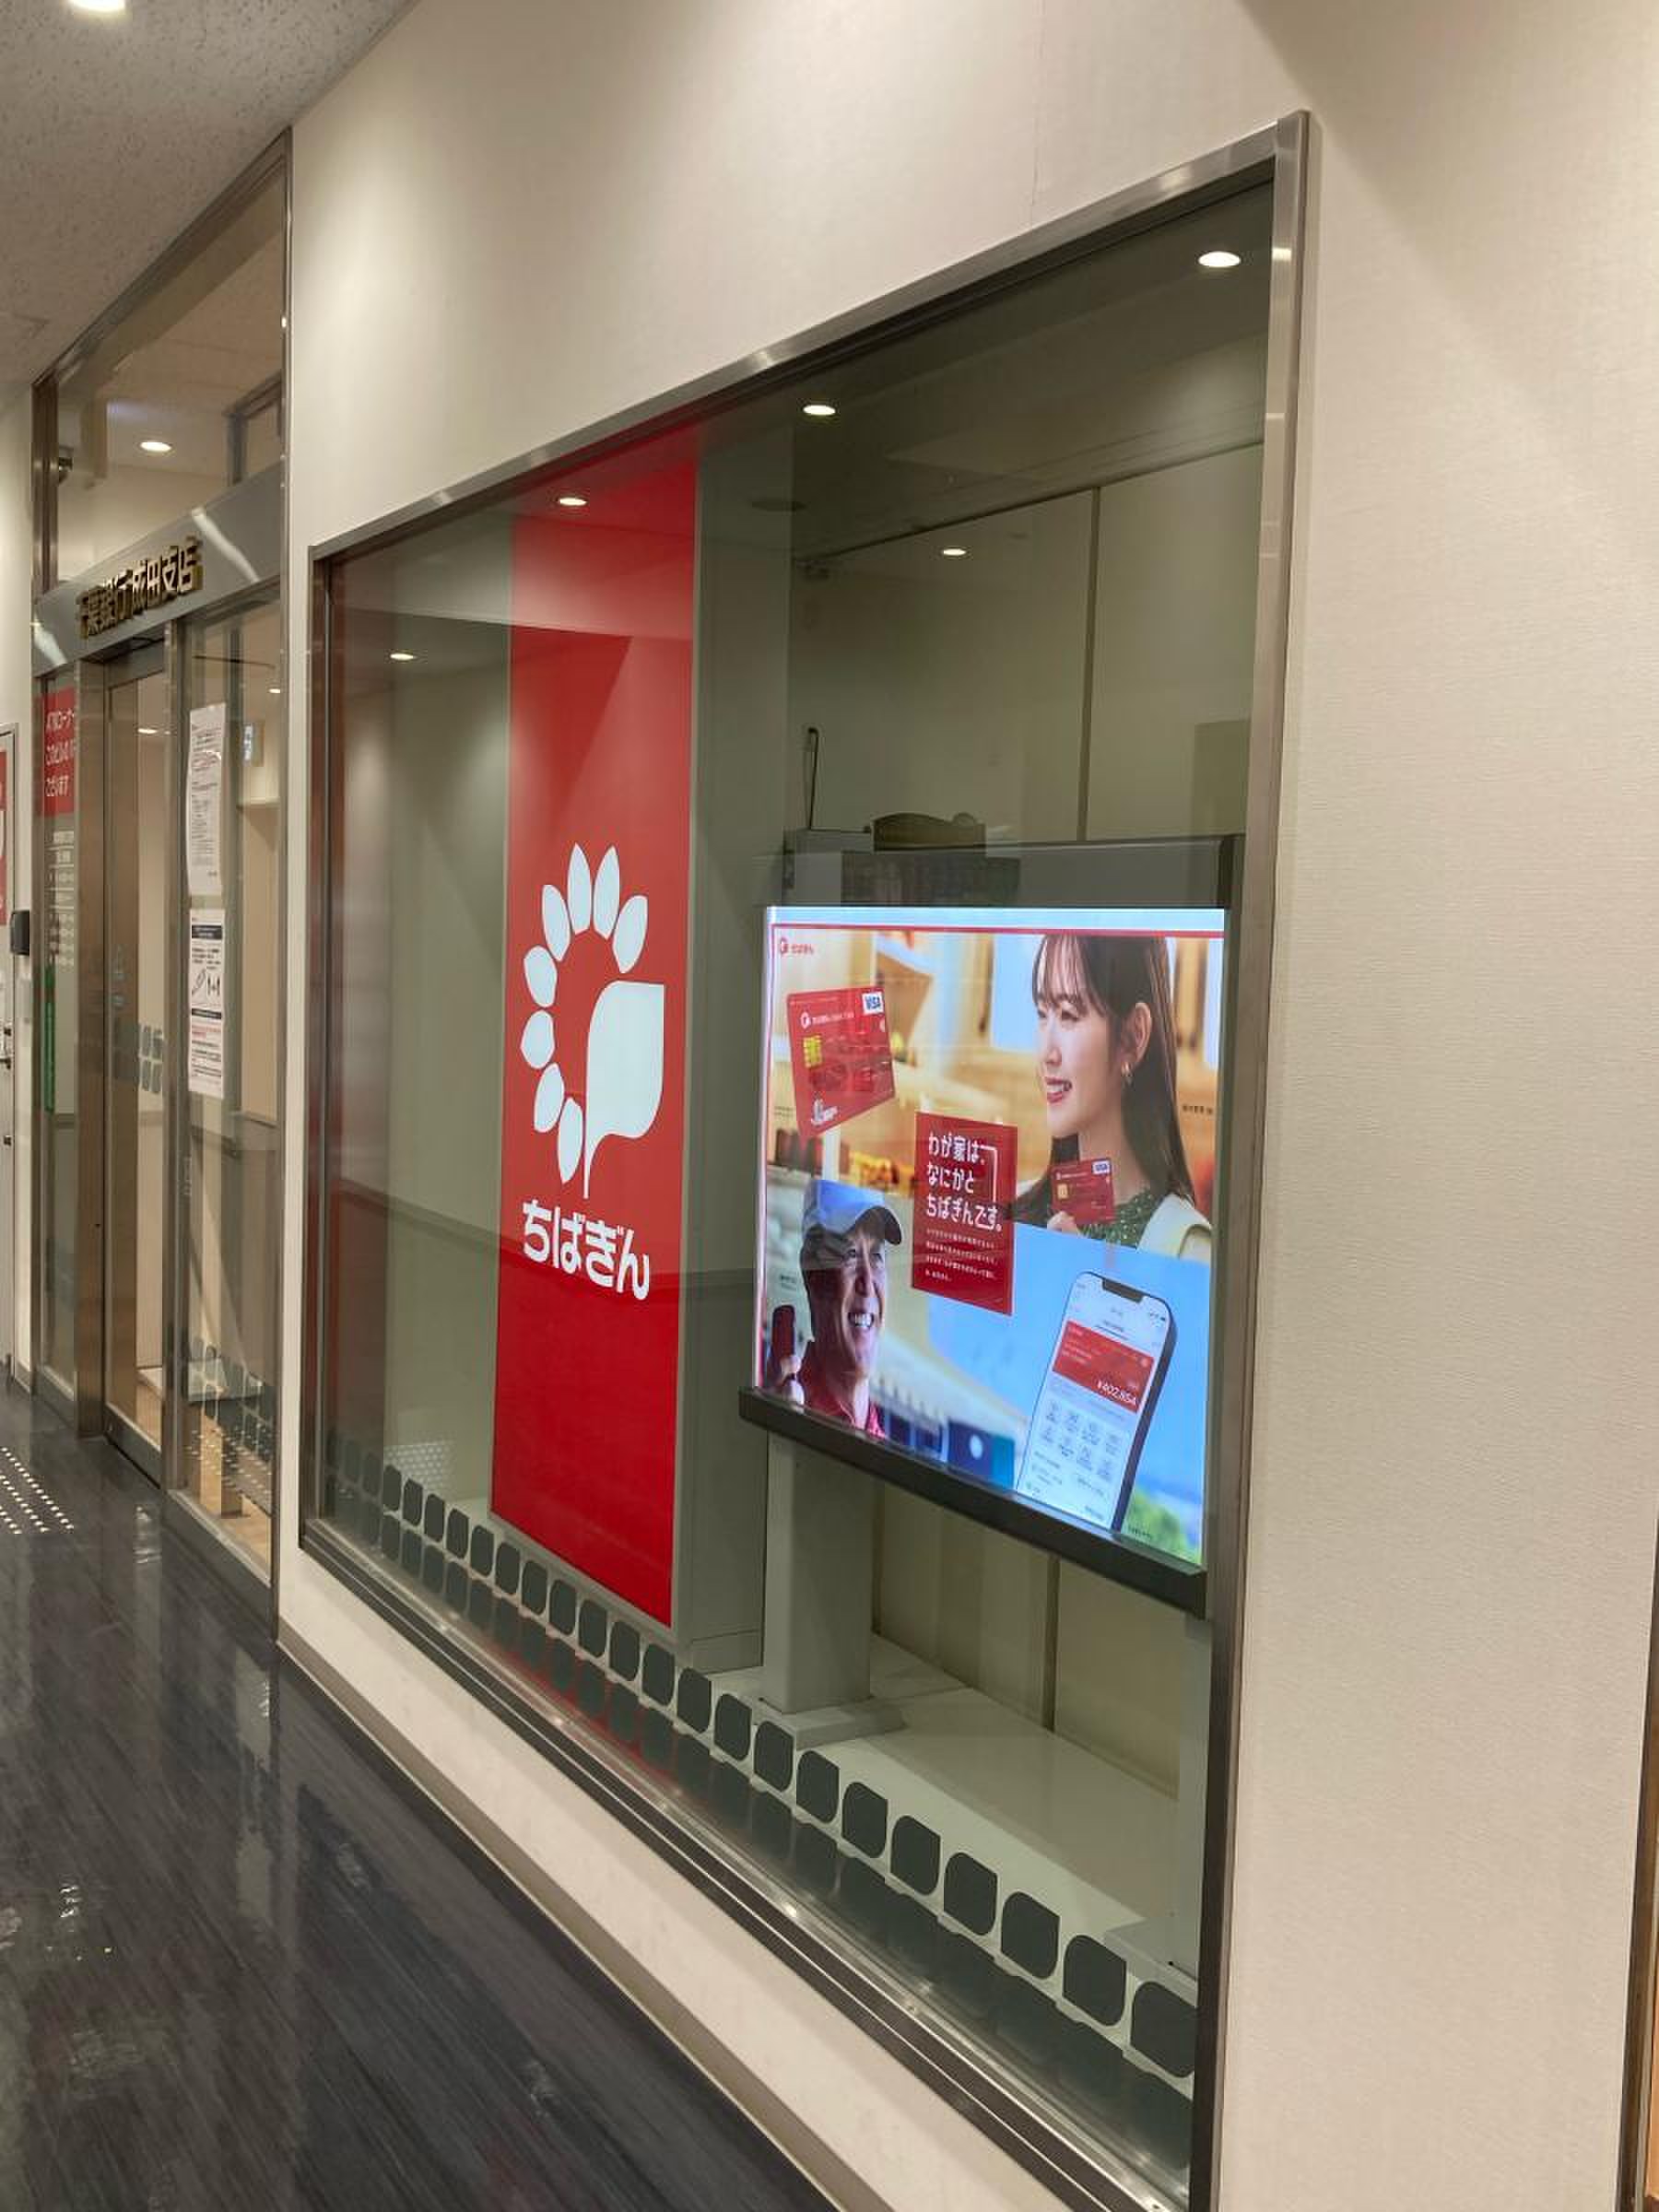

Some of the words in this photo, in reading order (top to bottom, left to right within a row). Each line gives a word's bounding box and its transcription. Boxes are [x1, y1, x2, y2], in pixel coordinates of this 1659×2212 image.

[926, 1161, 974, 1194] なにかと
[523, 1199, 650, 1300] ちばぎん
